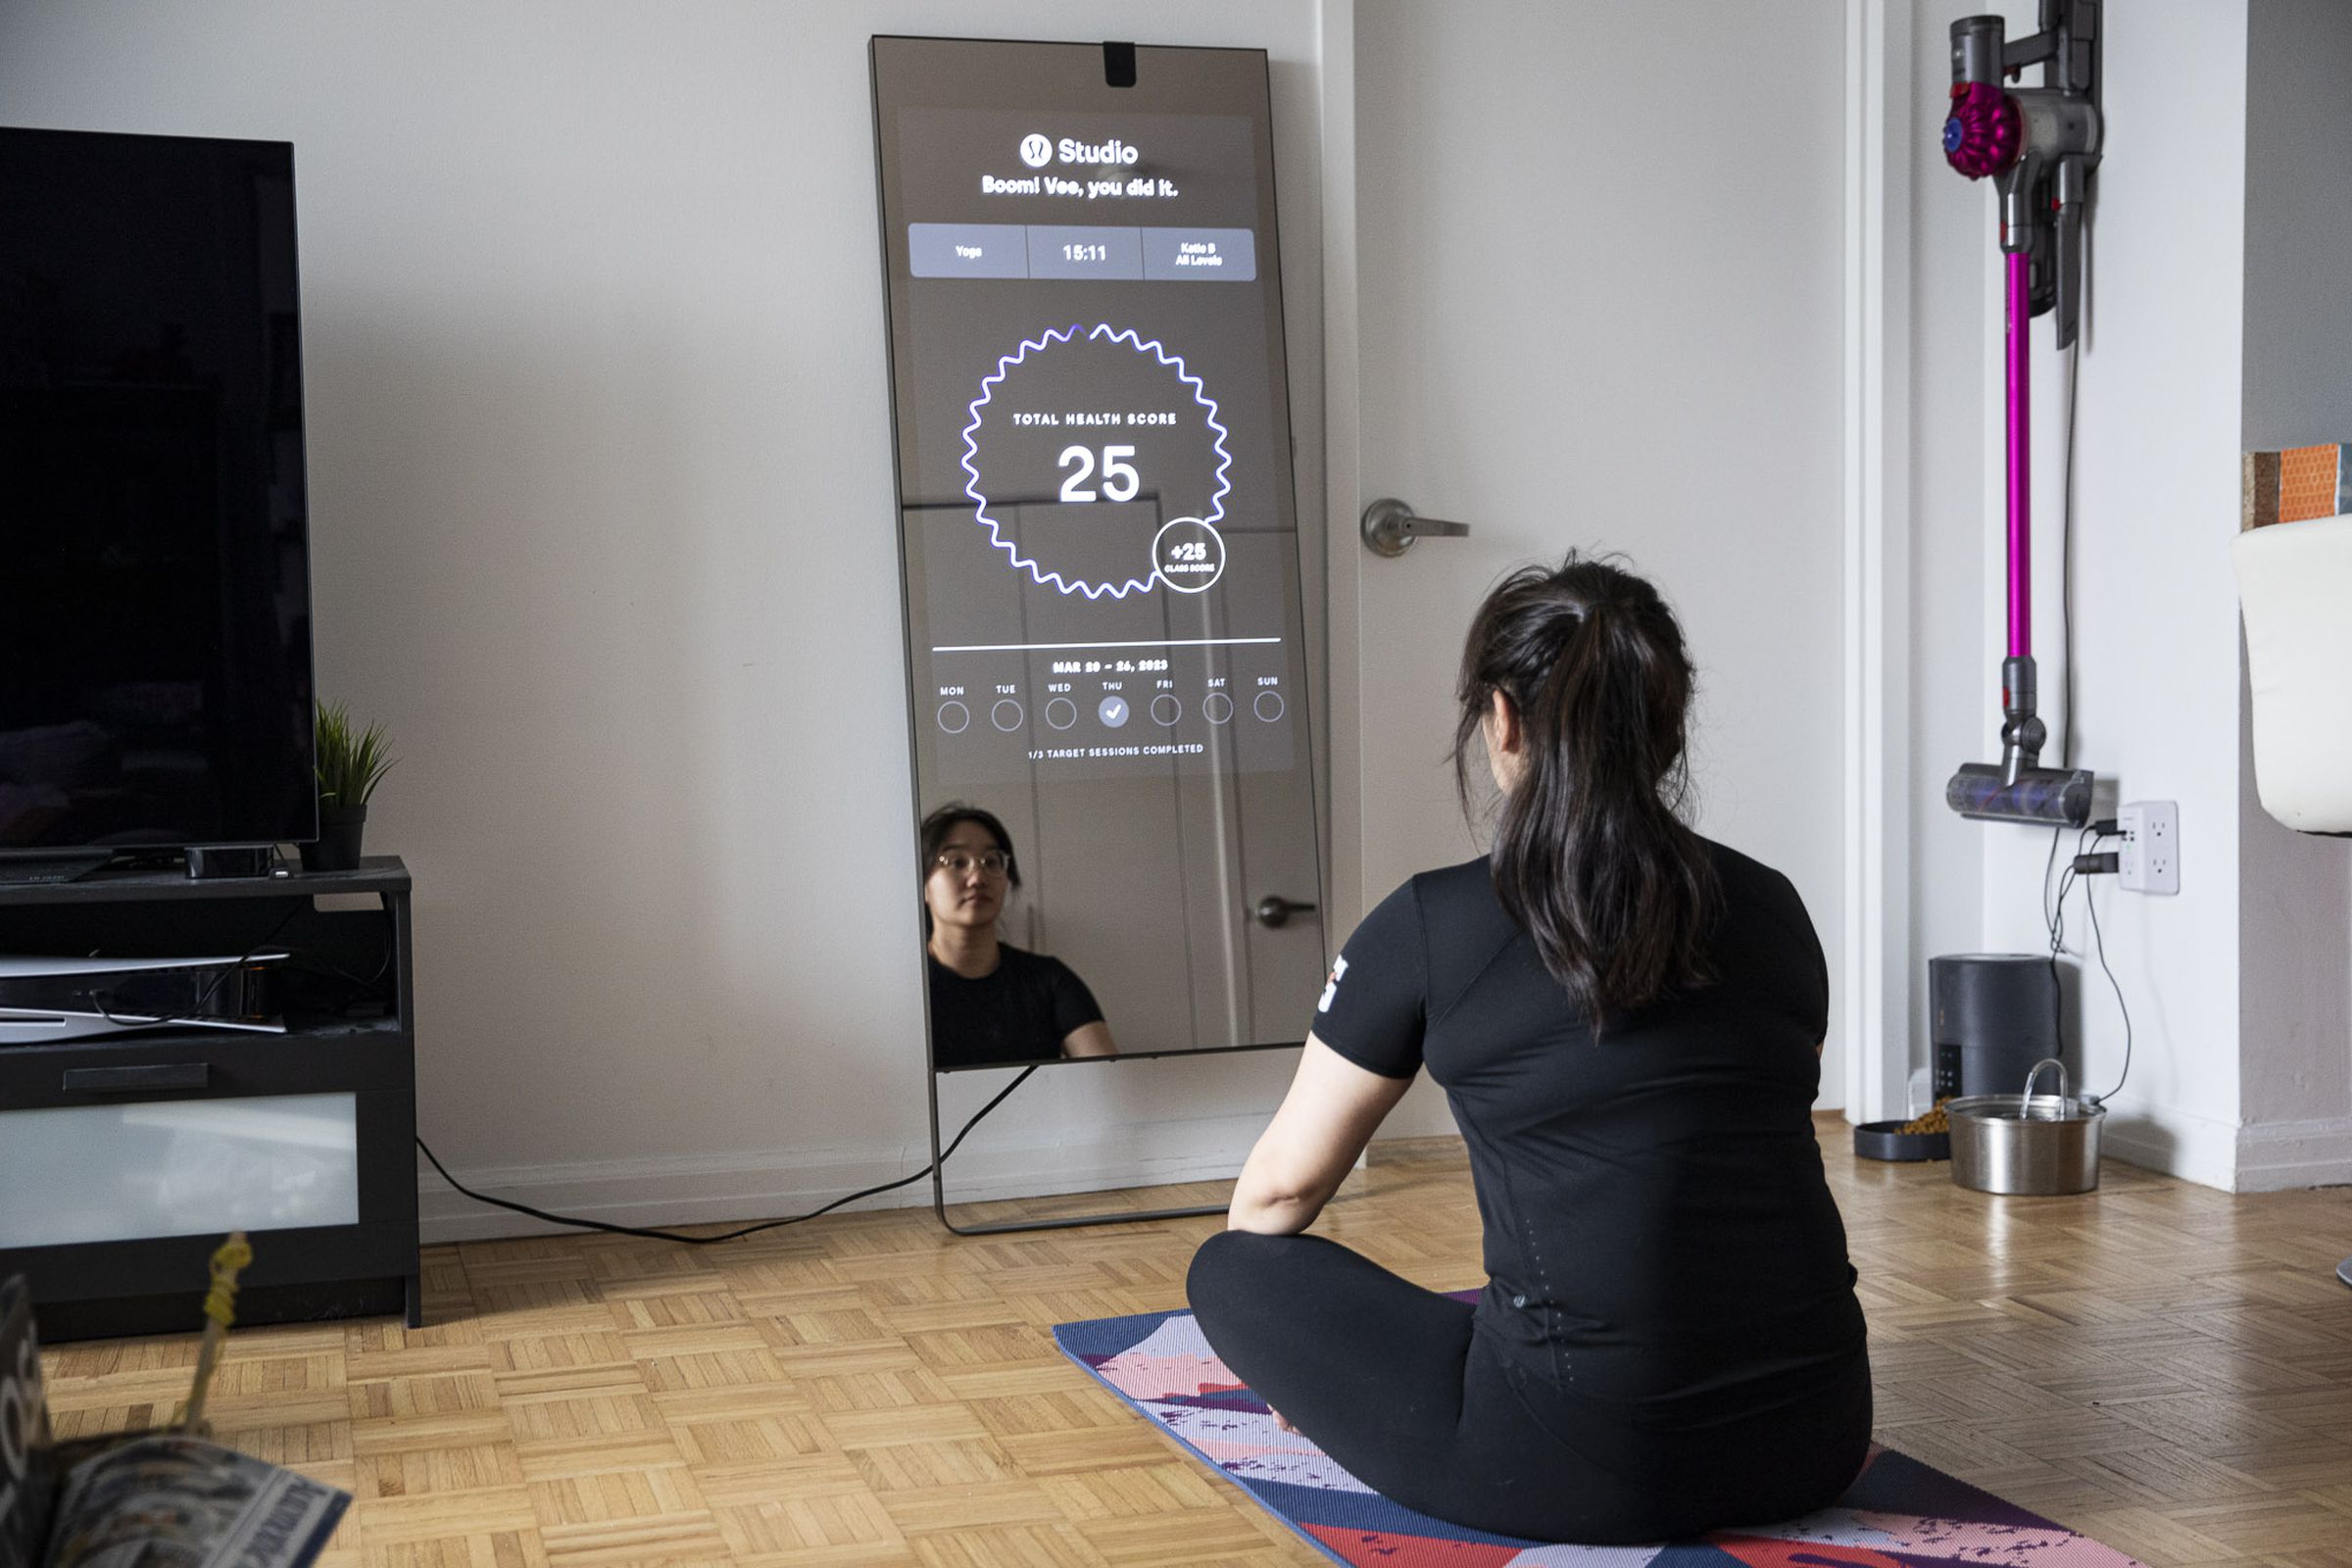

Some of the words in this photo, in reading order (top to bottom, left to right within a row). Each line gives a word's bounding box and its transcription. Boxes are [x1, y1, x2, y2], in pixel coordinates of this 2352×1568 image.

[1058, 139, 1138, 164] Studio
[982, 175, 1040, 194] Boom!
[1044, 176, 1084, 197] Vee,
[1088, 180, 1122, 198] you
[1127, 178, 1154, 196] did
[1158, 179, 1178, 196] it.
[956, 246, 982, 259] Yoga
[1063, 245, 1105, 261] 15:11
[1181, 243, 1206, 254] Katie
[1208, 243, 1215, 254] B
[1176, 255, 1190, 265] All
[1191, 255, 1222, 266] Levels
[1013, 414, 1058, 425] TOTAL
[1066, 414, 1120, 424] HEALTH
[1128, 414, 1176, 424] SCORE
[1058, 446, 1139, 502] 25
[1171, 543, 1206, 561] +25
[1164, 564, 1189, 573] CLASS
[1190, 564, 1215, 573] SCORE
[1053, 662, 1081, 673] MAR
[1086, 661, 1101, 673] 20
[1116, 661, 1135, 672] 26,
[1139, 659, 1168, 671] 2023
[1102, 681, 1121, 691] THU
[1156, 679, 1172, 689] FRI
[1208, 677, 1225, 688] SAT
[1258, 676, 1278, 686] SUN
[941, 686, 963, 696] MON
[997, 684, 1015, 694] TUE
[1049, 683, 1070, 693] WED
[1029, 750, 1043, 760] 1/3
[1048, 748, 1085, 759] TARGET
[1089, 746, 1139, 758] SESSIONS
[1144, 743, 1202, 756] COMPLETED
